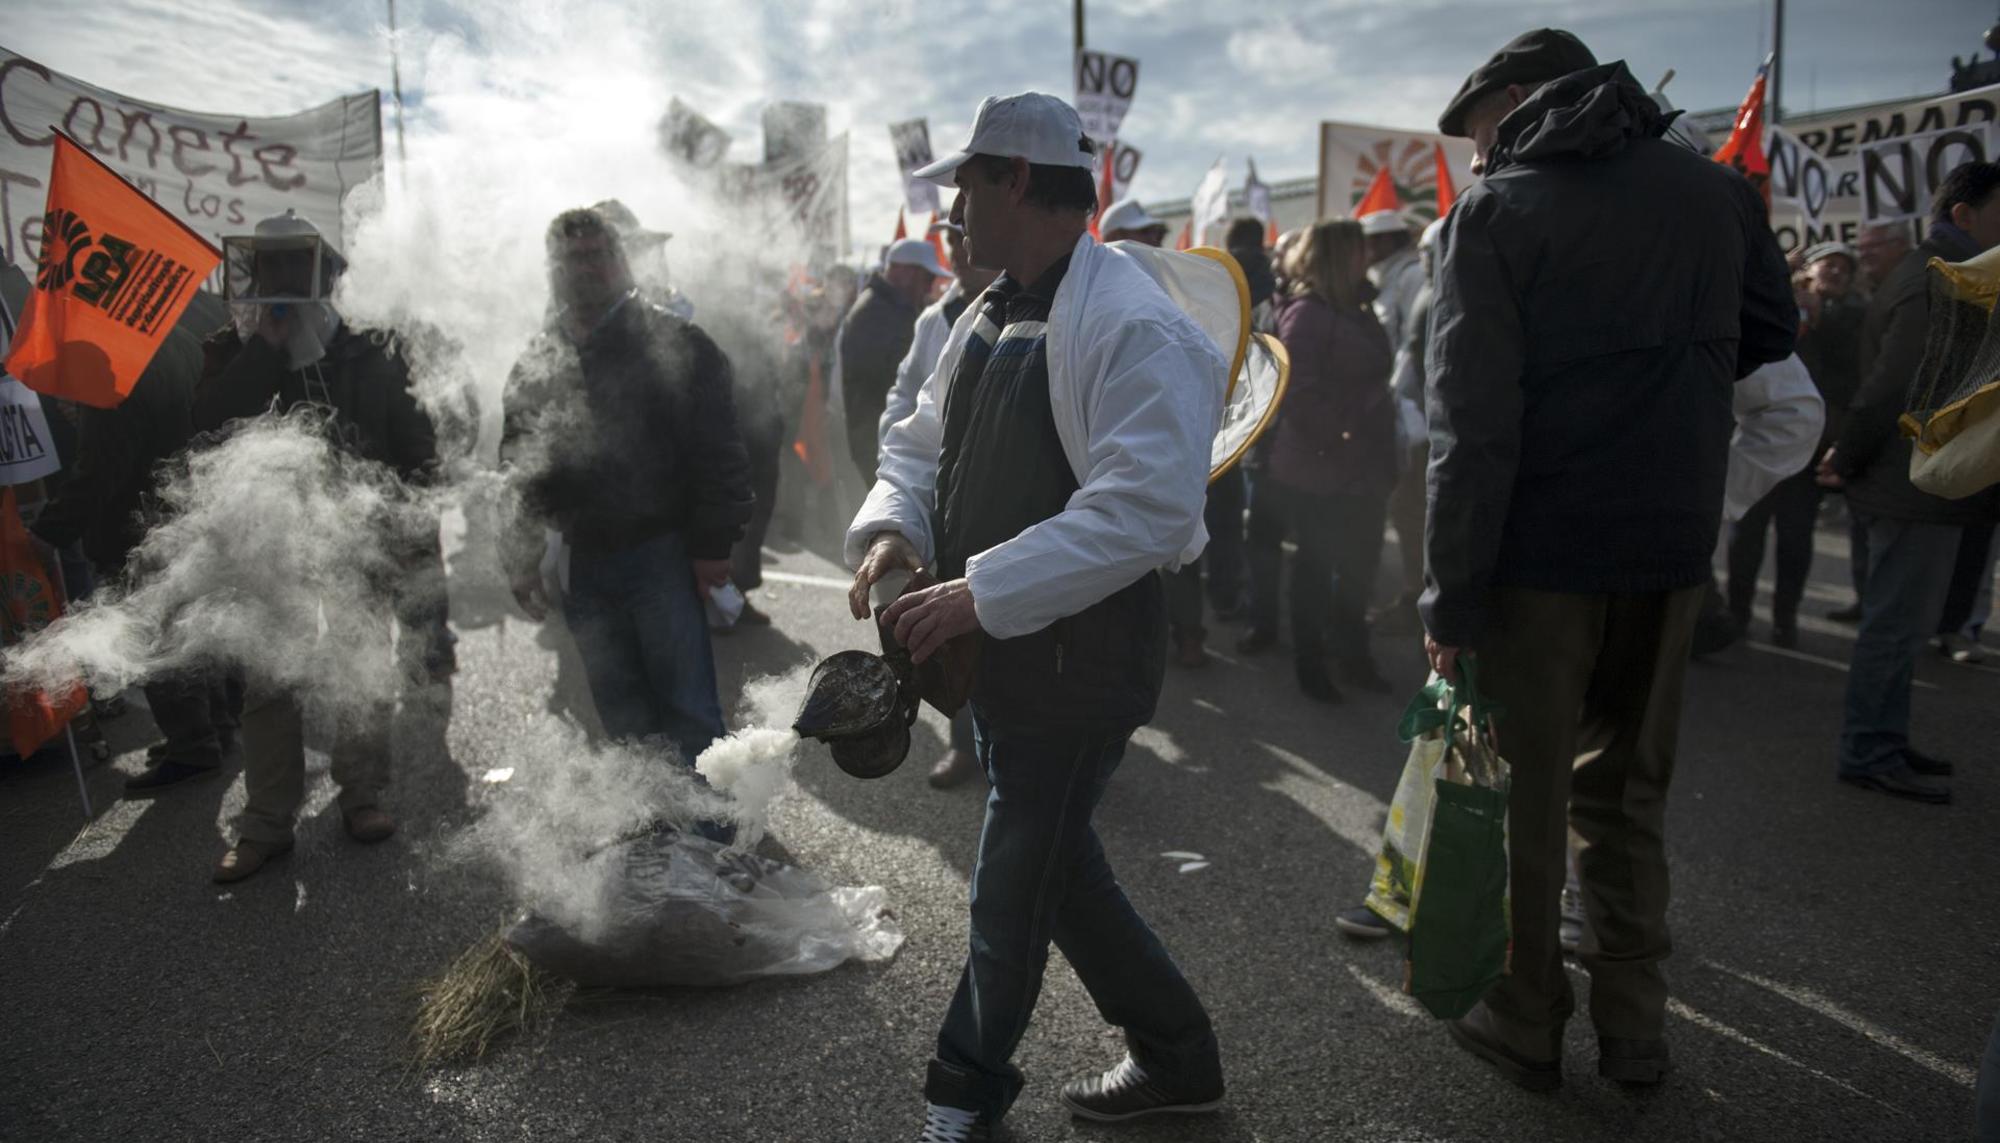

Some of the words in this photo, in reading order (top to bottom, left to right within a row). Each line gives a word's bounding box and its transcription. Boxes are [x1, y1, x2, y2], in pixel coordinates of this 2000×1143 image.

[1079, 53, 1137, 98] NO
[1768, 131, 1827, 219] NO
[1861, 130, 1985, 226] NO
